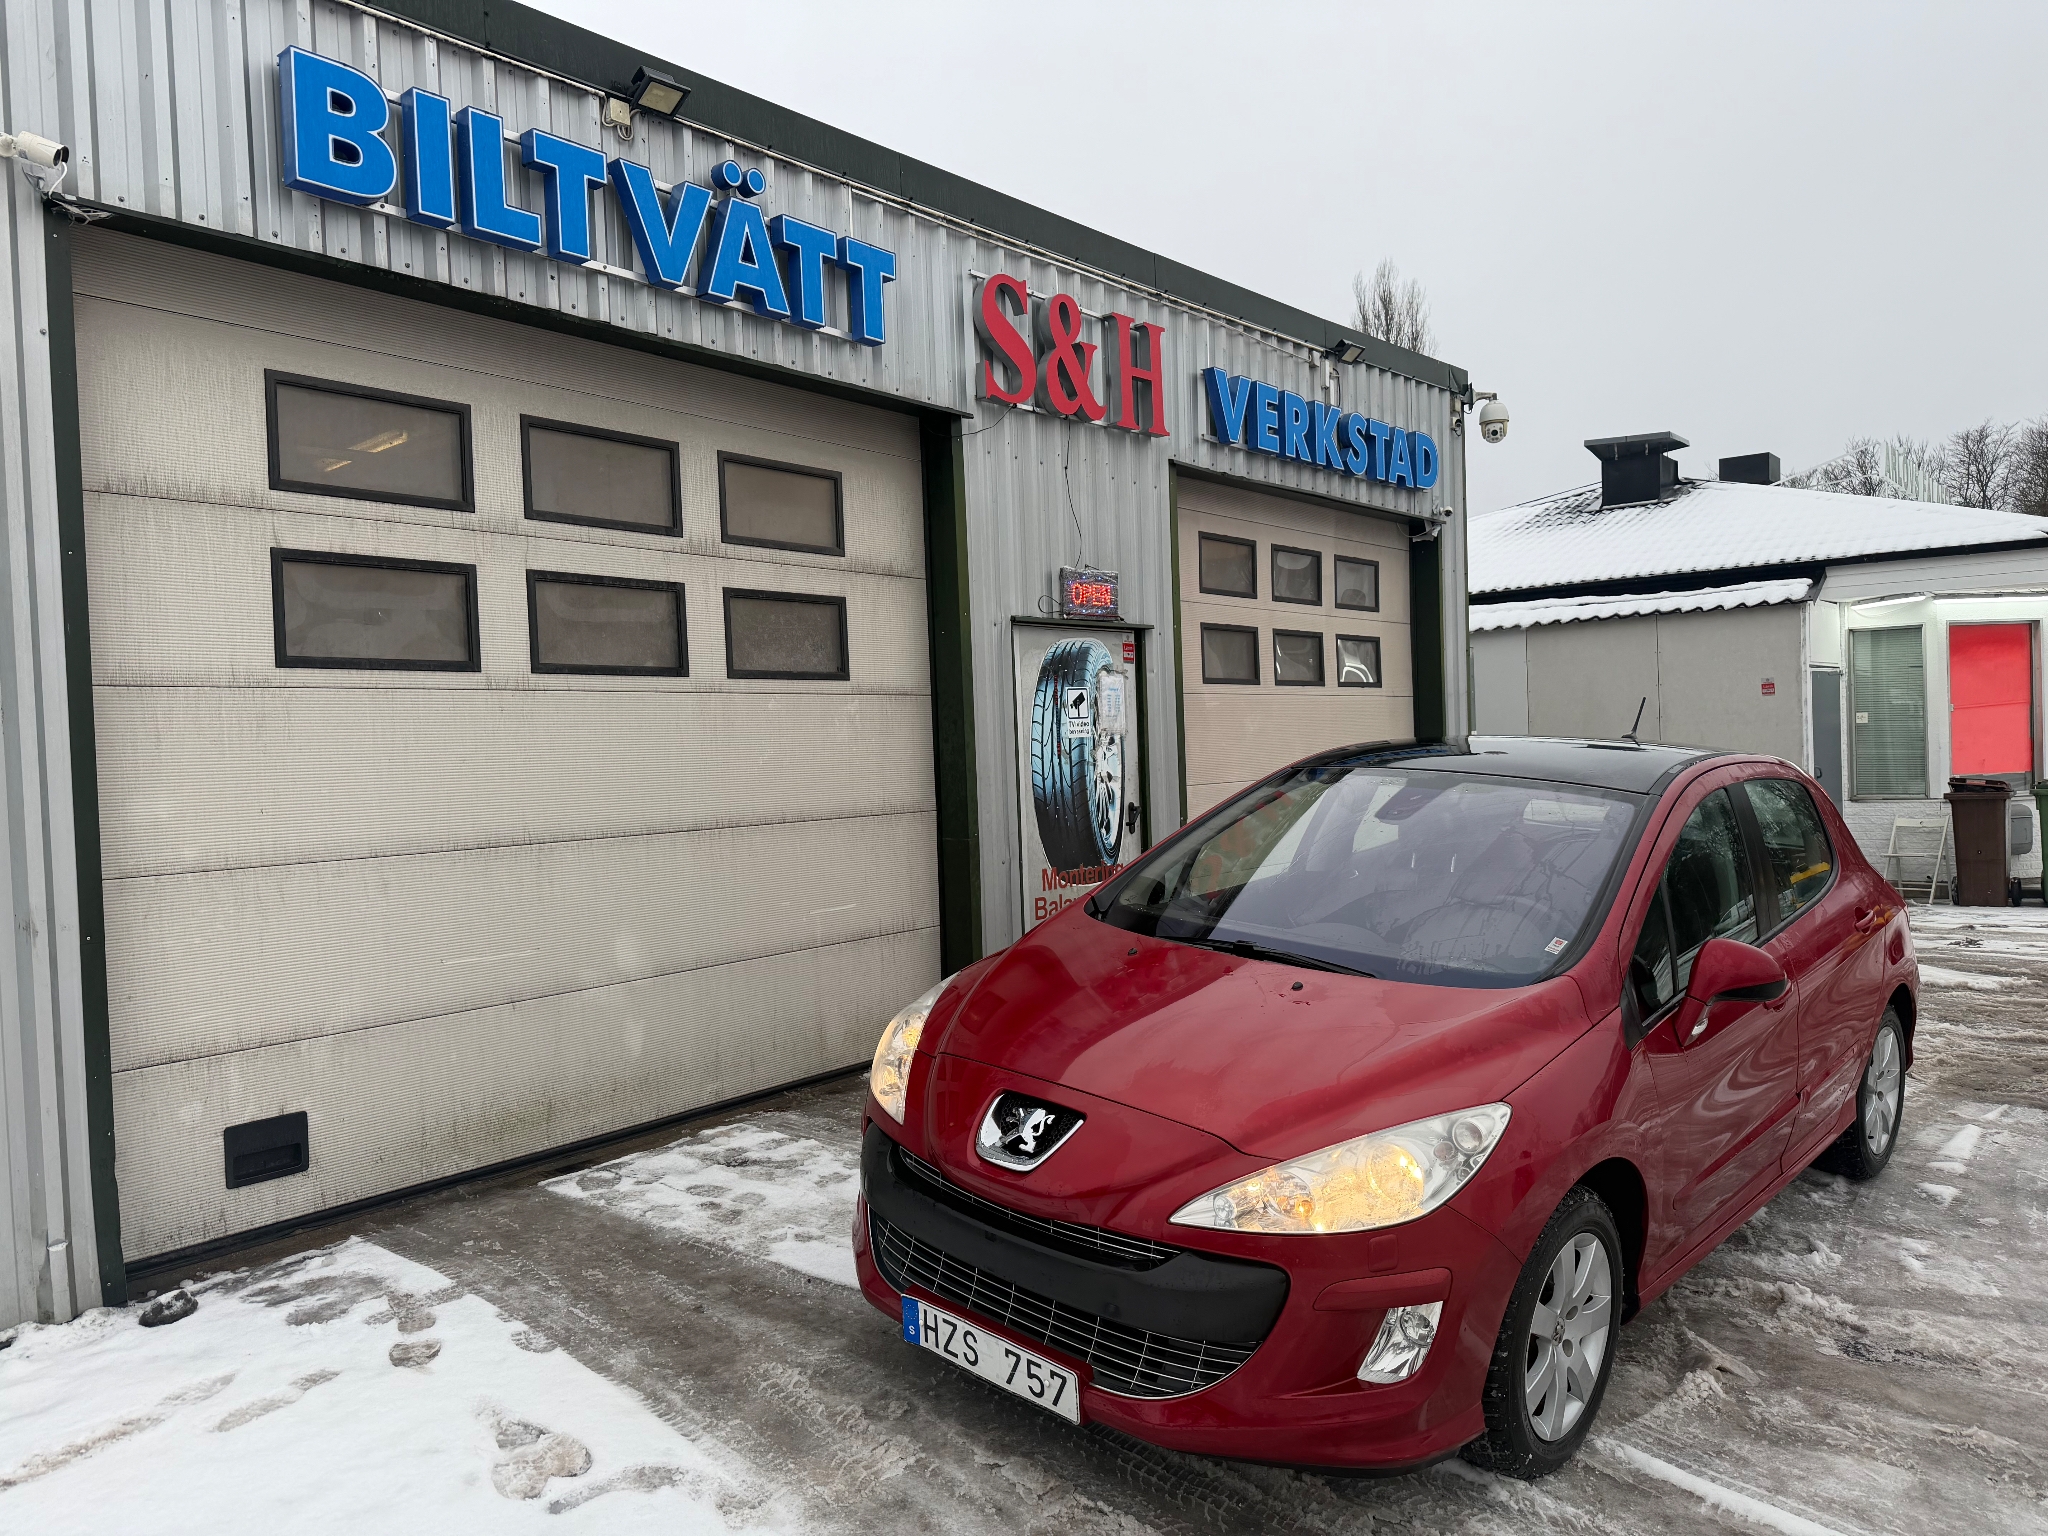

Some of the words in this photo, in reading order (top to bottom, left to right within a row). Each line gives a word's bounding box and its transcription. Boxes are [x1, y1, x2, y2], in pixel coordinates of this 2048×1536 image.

[277, 44, 896, 347] BILTVÄTT
[975, 274, 1170, 437] S&H
[1203, 366, 1439, 490] VERKSTAD
[1072, 583, 1111, 606] OPEN
[908, 1325, 915, 1334] S
[923, 1309, 979, 1366] HZS
[1004, 1347, 1067, 1407] 757
